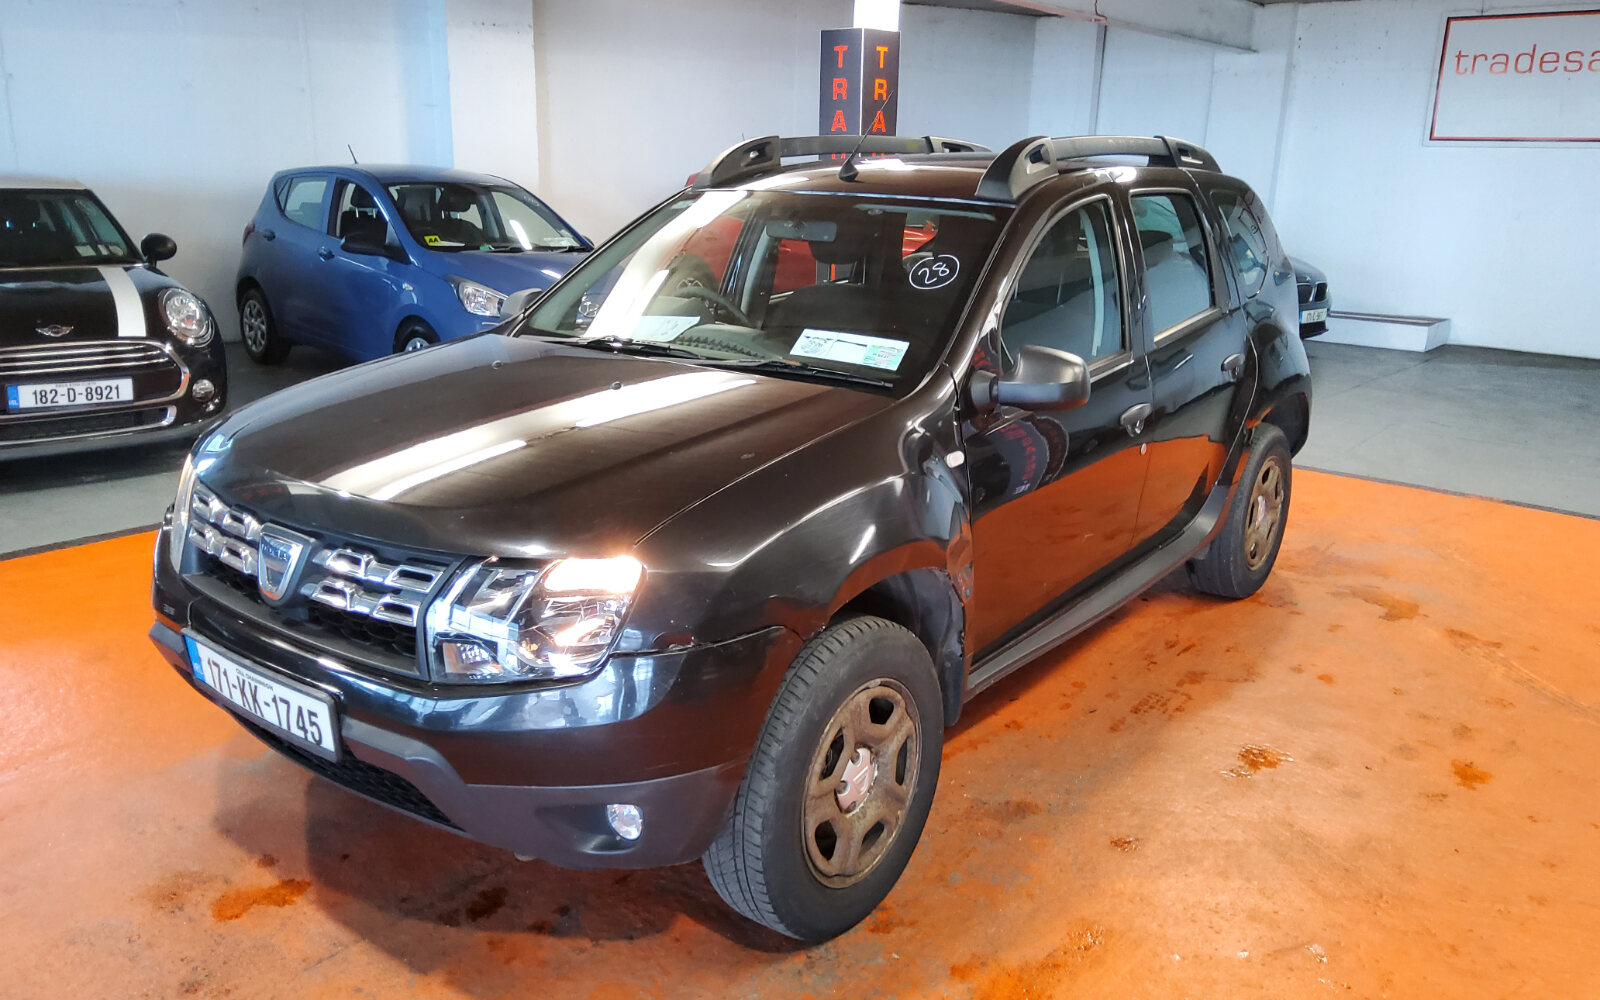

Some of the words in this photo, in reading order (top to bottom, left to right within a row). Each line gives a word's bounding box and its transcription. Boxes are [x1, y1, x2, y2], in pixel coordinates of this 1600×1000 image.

[871, 45, 889, 158] TRA
[918, 262, 950, 284] 28
[32, 384, 120, 406] 182-D-8921
[207, 657, 323, 746] 171-KK-1745
